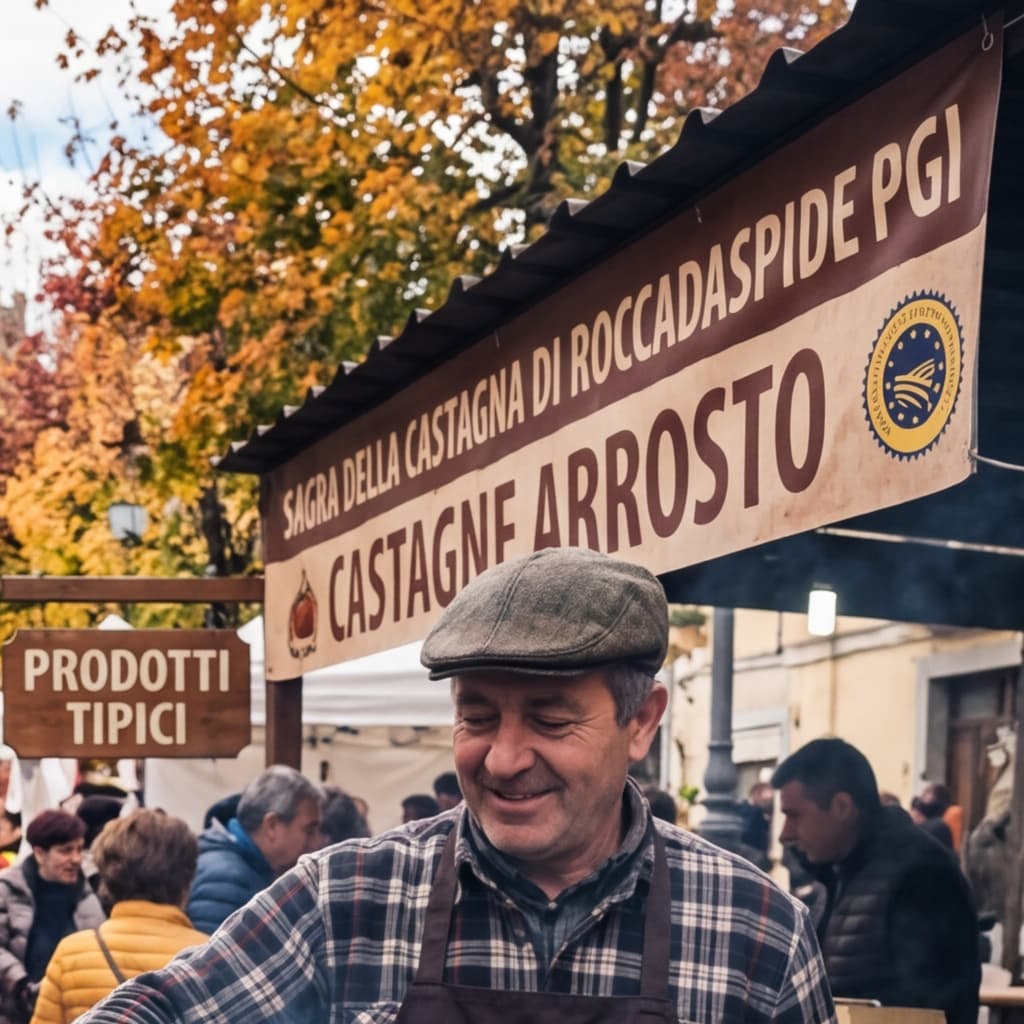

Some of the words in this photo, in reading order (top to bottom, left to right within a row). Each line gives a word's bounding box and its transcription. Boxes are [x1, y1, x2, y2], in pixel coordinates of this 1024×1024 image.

[283, 465, 339, 541] SAGRA
[342, 431, 401, 513] DELLA
[404, 359, 526, 479] CASTAGNA
[532, 336, 561, 417] DI
[570, 164, 860, 399] ROCCADASPIDE
[871, 103, 962, 243] PGI
[328, 479, 516, 643] CASTAGNE
[532, 347, 826, 553] ARROSTO
[24, 648, 230, 693] PRODOTTI
[65, 701, 187, 745] TIPICI
